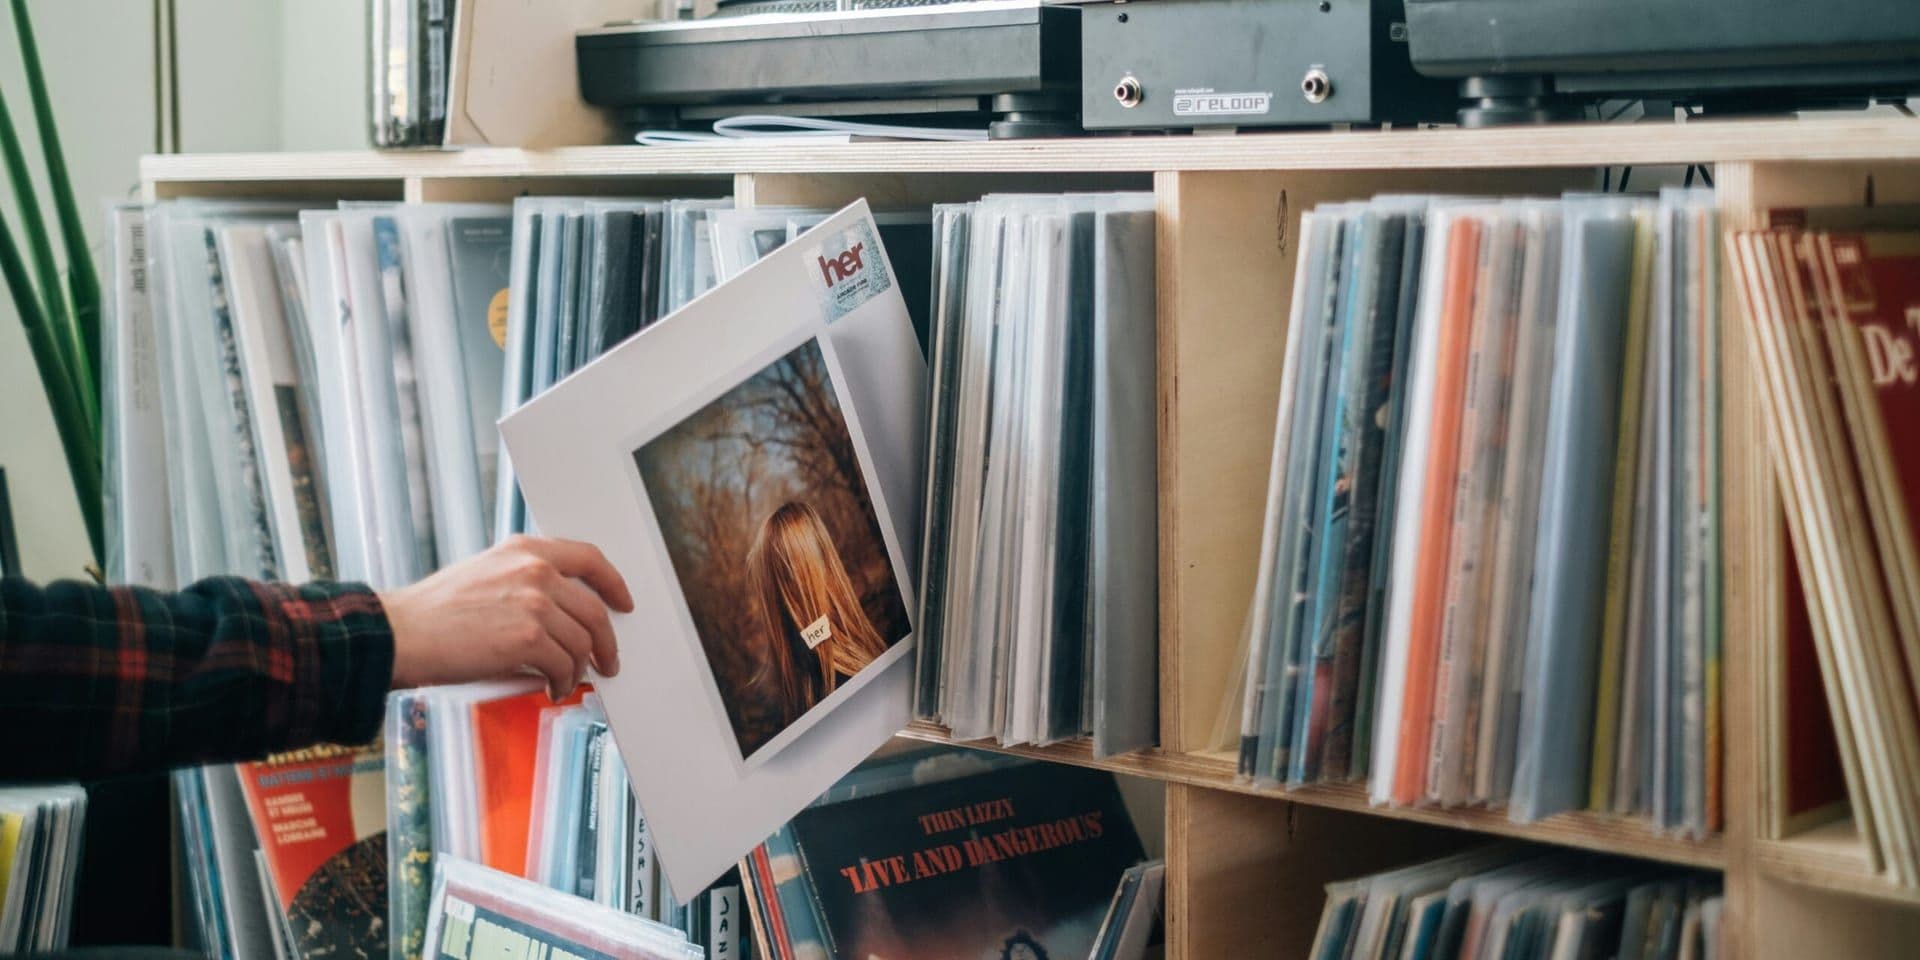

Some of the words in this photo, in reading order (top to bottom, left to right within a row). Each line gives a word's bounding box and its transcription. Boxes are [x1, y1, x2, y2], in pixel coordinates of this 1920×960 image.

[818, 242, 863, 288] her
[1860, 324, 1917, 385] De
[806, 625, 824, 643] her
[918, 807, 966, 836] THIN
[967, 798, 1015, 826] LIZZY
[913, 844, 963, 880] AND
[634, 879, 644, 915] JA
[718, 895, 730, 960] JAZ
